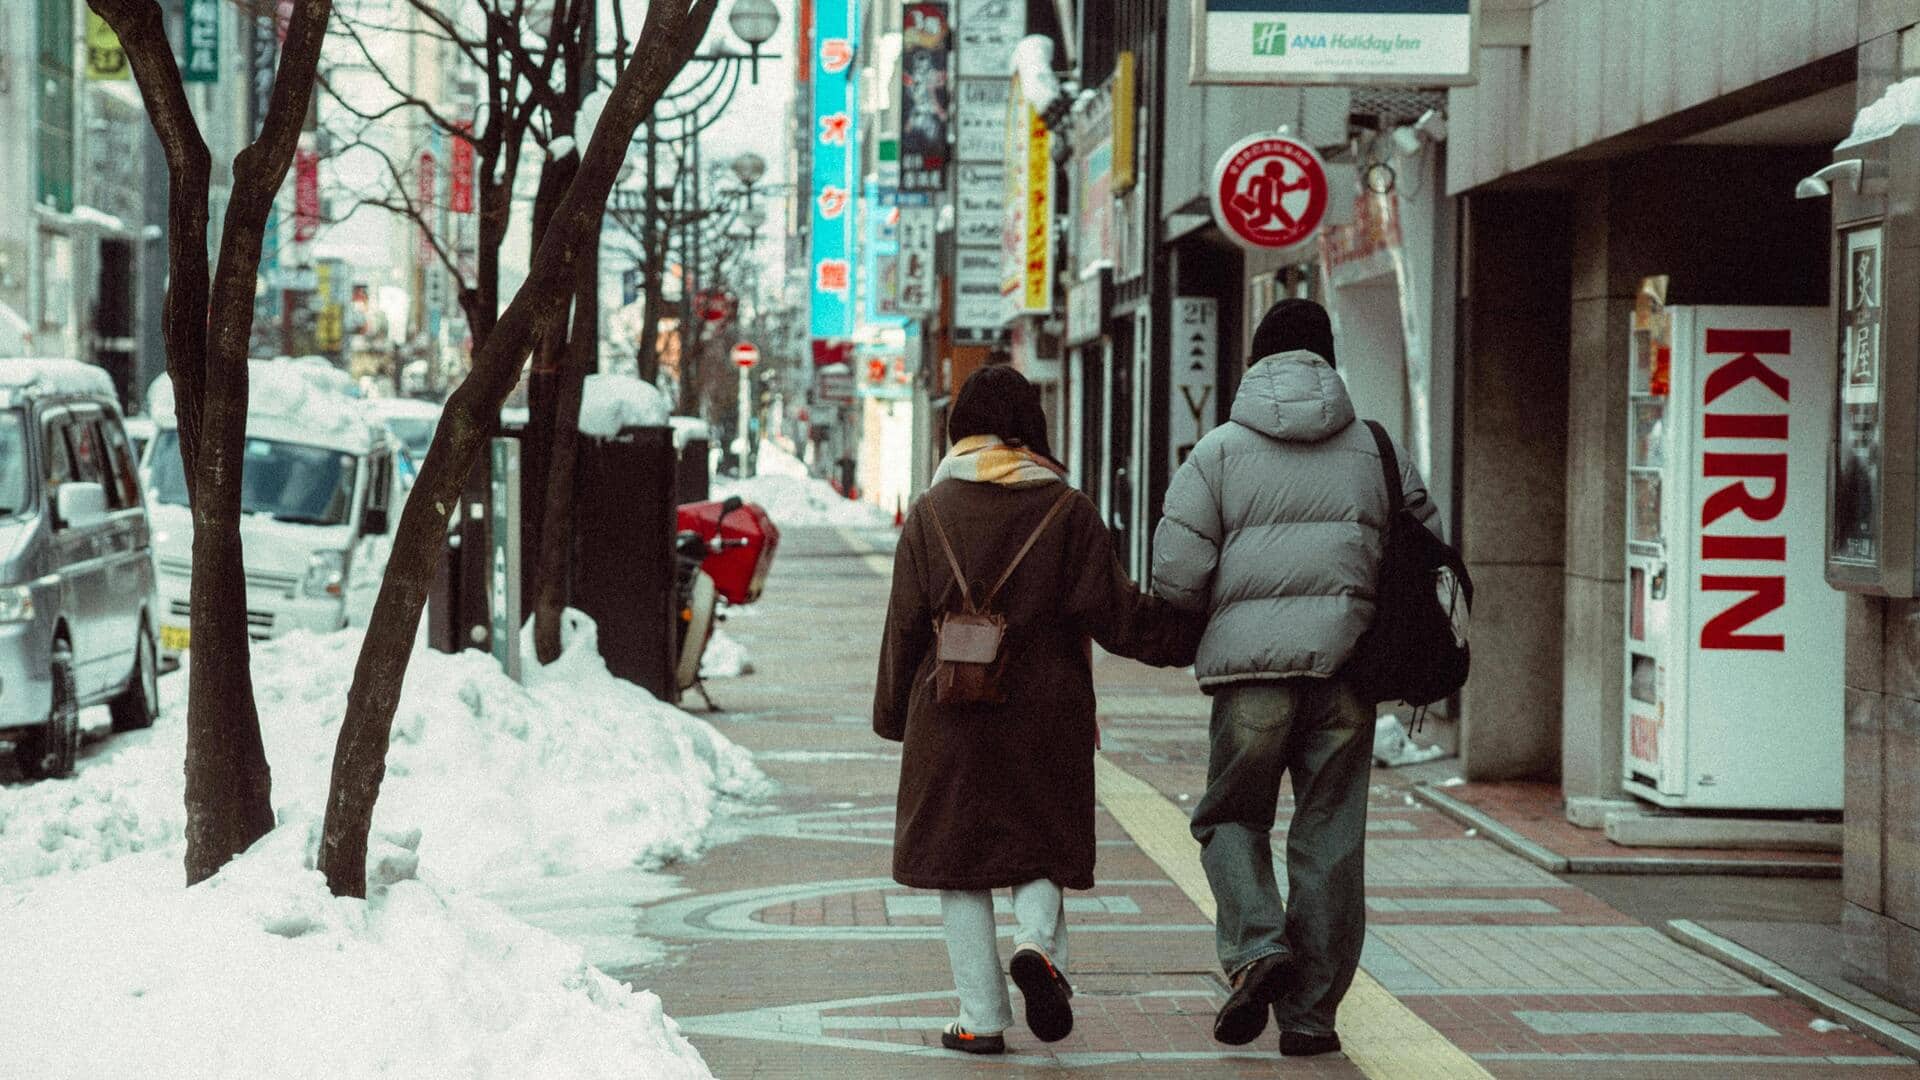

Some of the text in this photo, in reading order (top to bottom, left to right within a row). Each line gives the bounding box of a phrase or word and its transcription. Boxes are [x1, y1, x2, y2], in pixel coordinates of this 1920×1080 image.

[1291, 33, 1422, 54] ANA Holiday Inn
[1699, 328, 1791, 652] KIRIN
